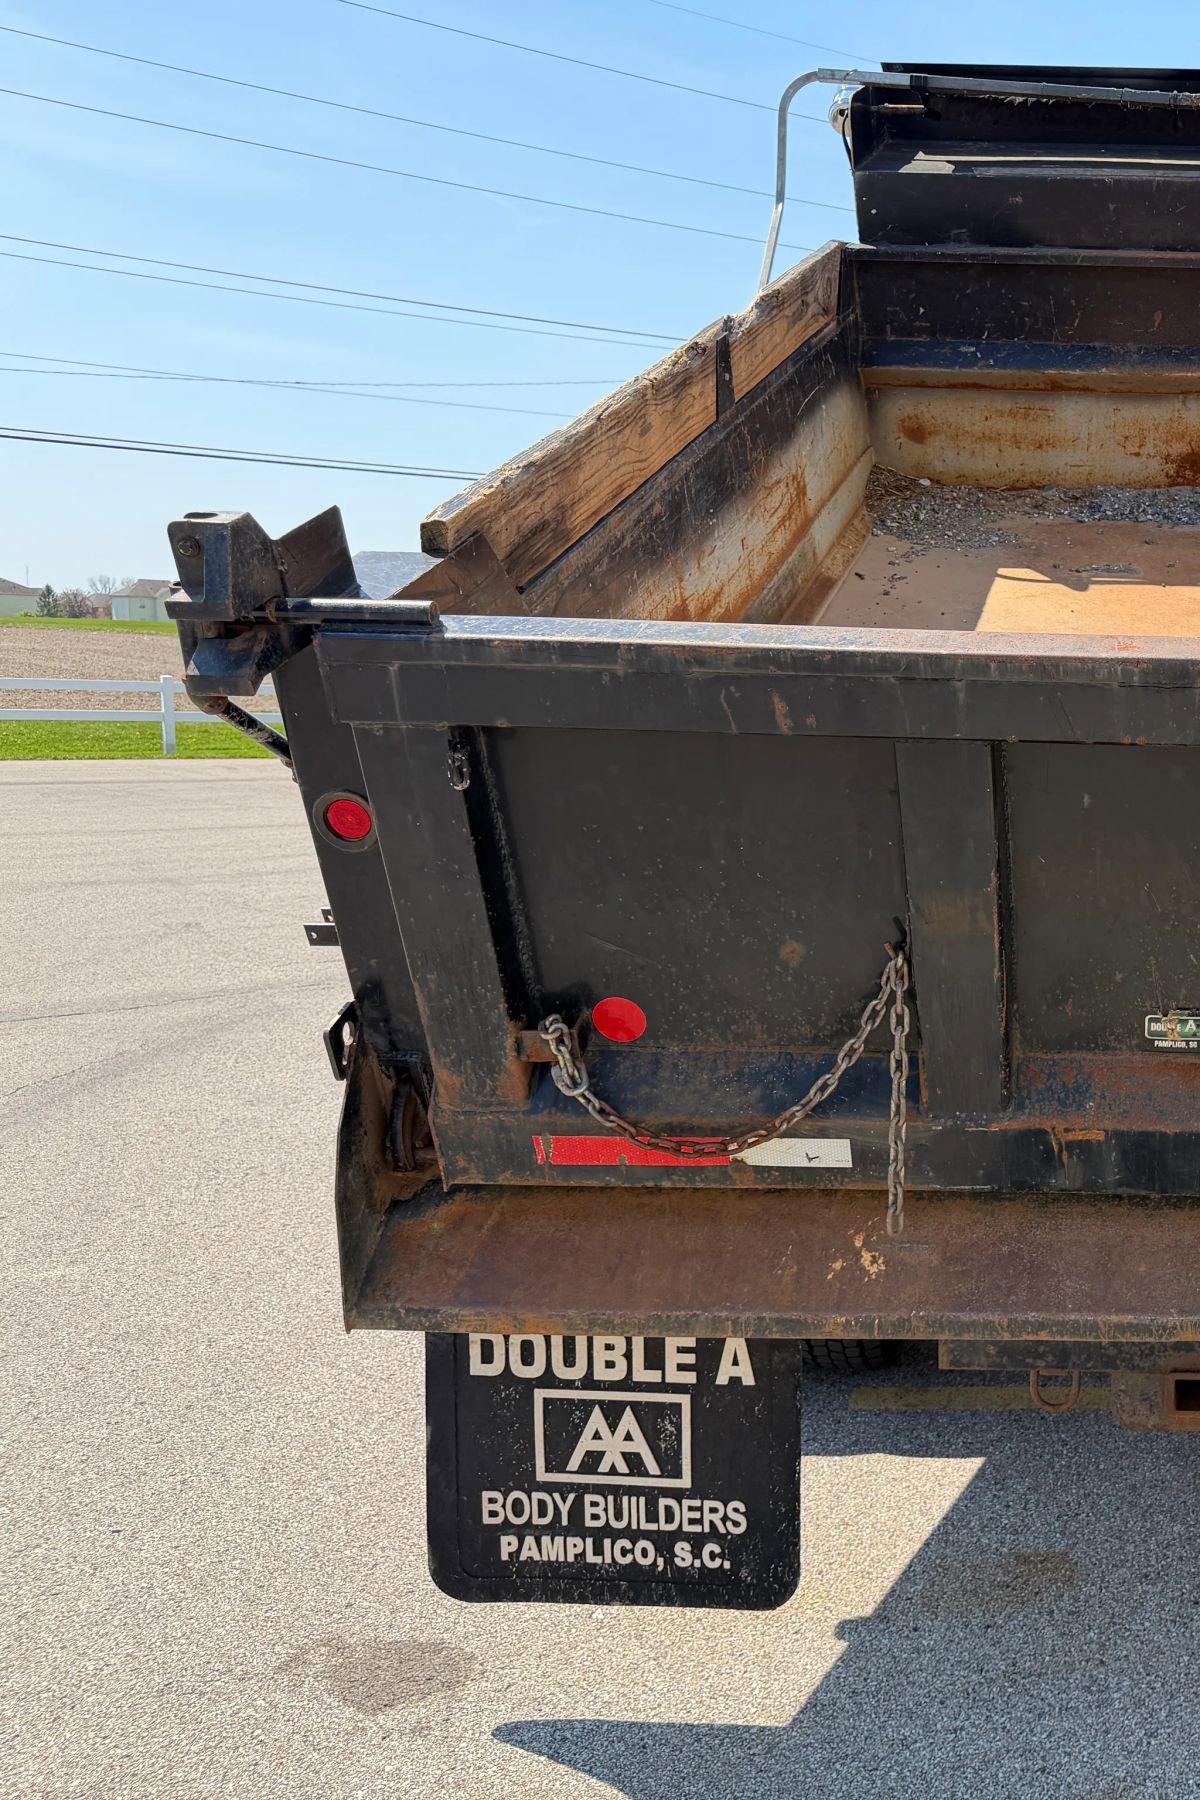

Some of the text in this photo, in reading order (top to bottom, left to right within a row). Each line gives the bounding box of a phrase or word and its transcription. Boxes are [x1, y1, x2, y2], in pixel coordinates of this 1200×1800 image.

[1150, 1022, 1182, 1032] DOUE
[1154, 1040, 1188, 1049] PAMPLICO,
[1189, 1041, 1198, 1049] SC
[468, 1332, 756, 1386] DOUBLE A
[481, 1490, 748, 1534] BODY BUILDERS
[500, 1535, 732, 1571] PAMPLICO, S.C.
